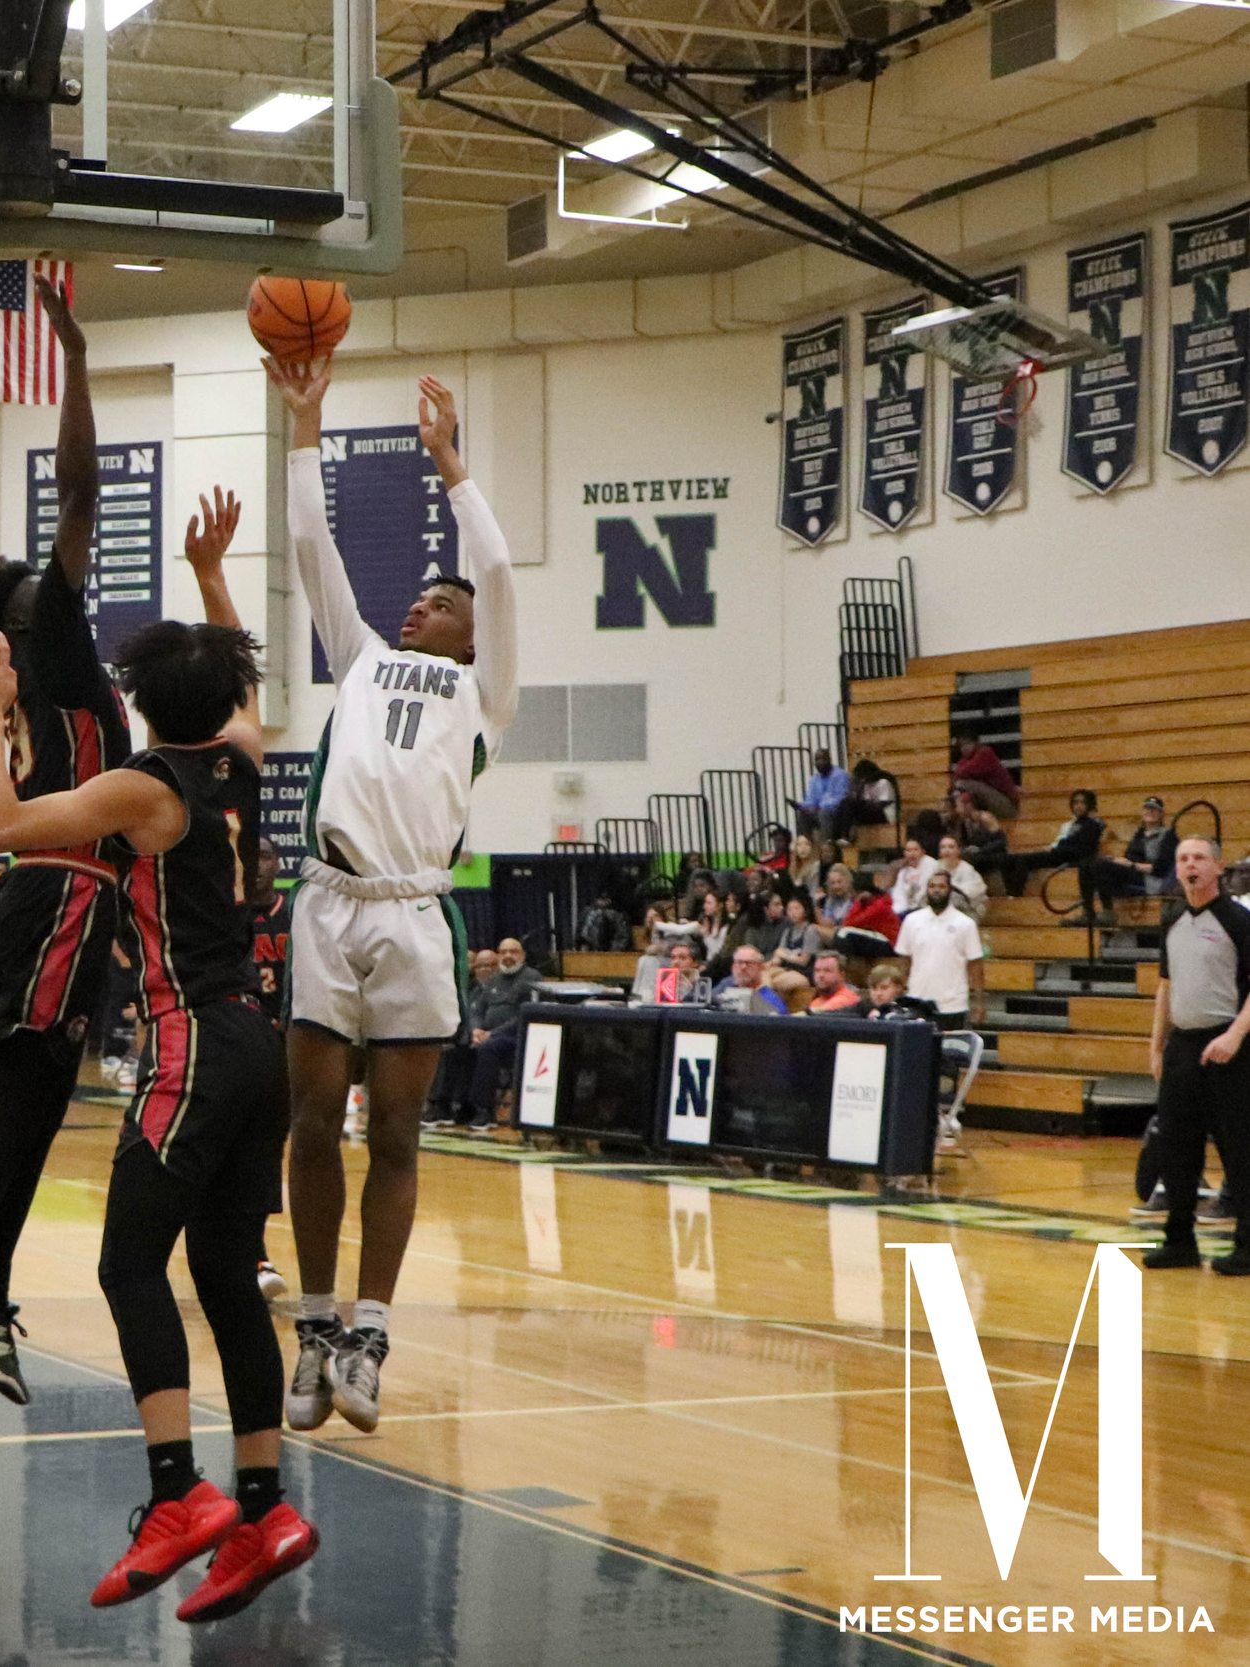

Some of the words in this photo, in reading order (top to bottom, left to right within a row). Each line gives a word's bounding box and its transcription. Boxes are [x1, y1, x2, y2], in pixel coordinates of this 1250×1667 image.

[1074, 269, 1137, 298] CHAMPIONS
[130, 448, 155, 474] N
[321, 436, 348, 462] N
[353, 436, 417, 454] NORTHVIEW
[583, 477, 731, 505] NORTHVIEW
[595, 513, 718, 630] N
[373, 660, 459, 700] TITANS
[385, 698, 424, 750] 11
[279, 787, 308, 800] COA
[675, 1057, 712, 1118] N
